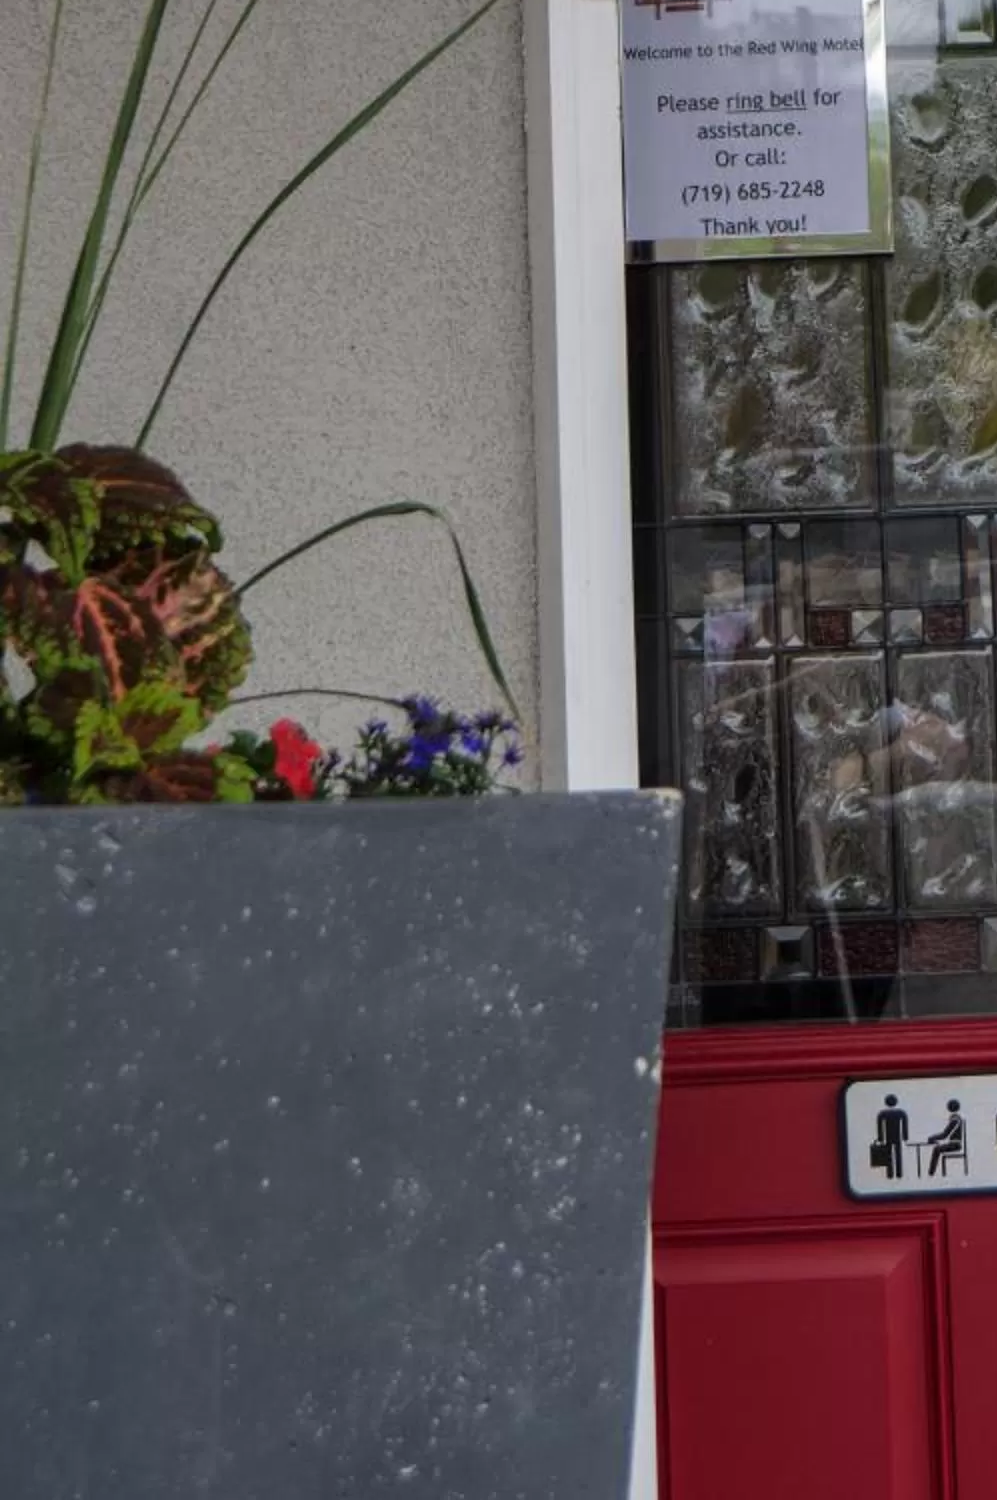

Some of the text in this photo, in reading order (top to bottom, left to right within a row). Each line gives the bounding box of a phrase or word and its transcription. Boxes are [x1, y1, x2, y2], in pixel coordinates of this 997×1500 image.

[623, 44, 693, 60] Welcome
[697, 43, 713, 57] to
[717, 43, 743, 57] the
[747, 40, 777, 55] Red
[781, 39, 818, 56] Wing
[657, 88, 841, 113] Please ring bell for
[697, 121, 802, 141] assistance.
[715, 148, 787, 168] Or call:
[681, 179, 825, 205] (719) 685-2248
[702, 213, 808, 236] Thank you!
